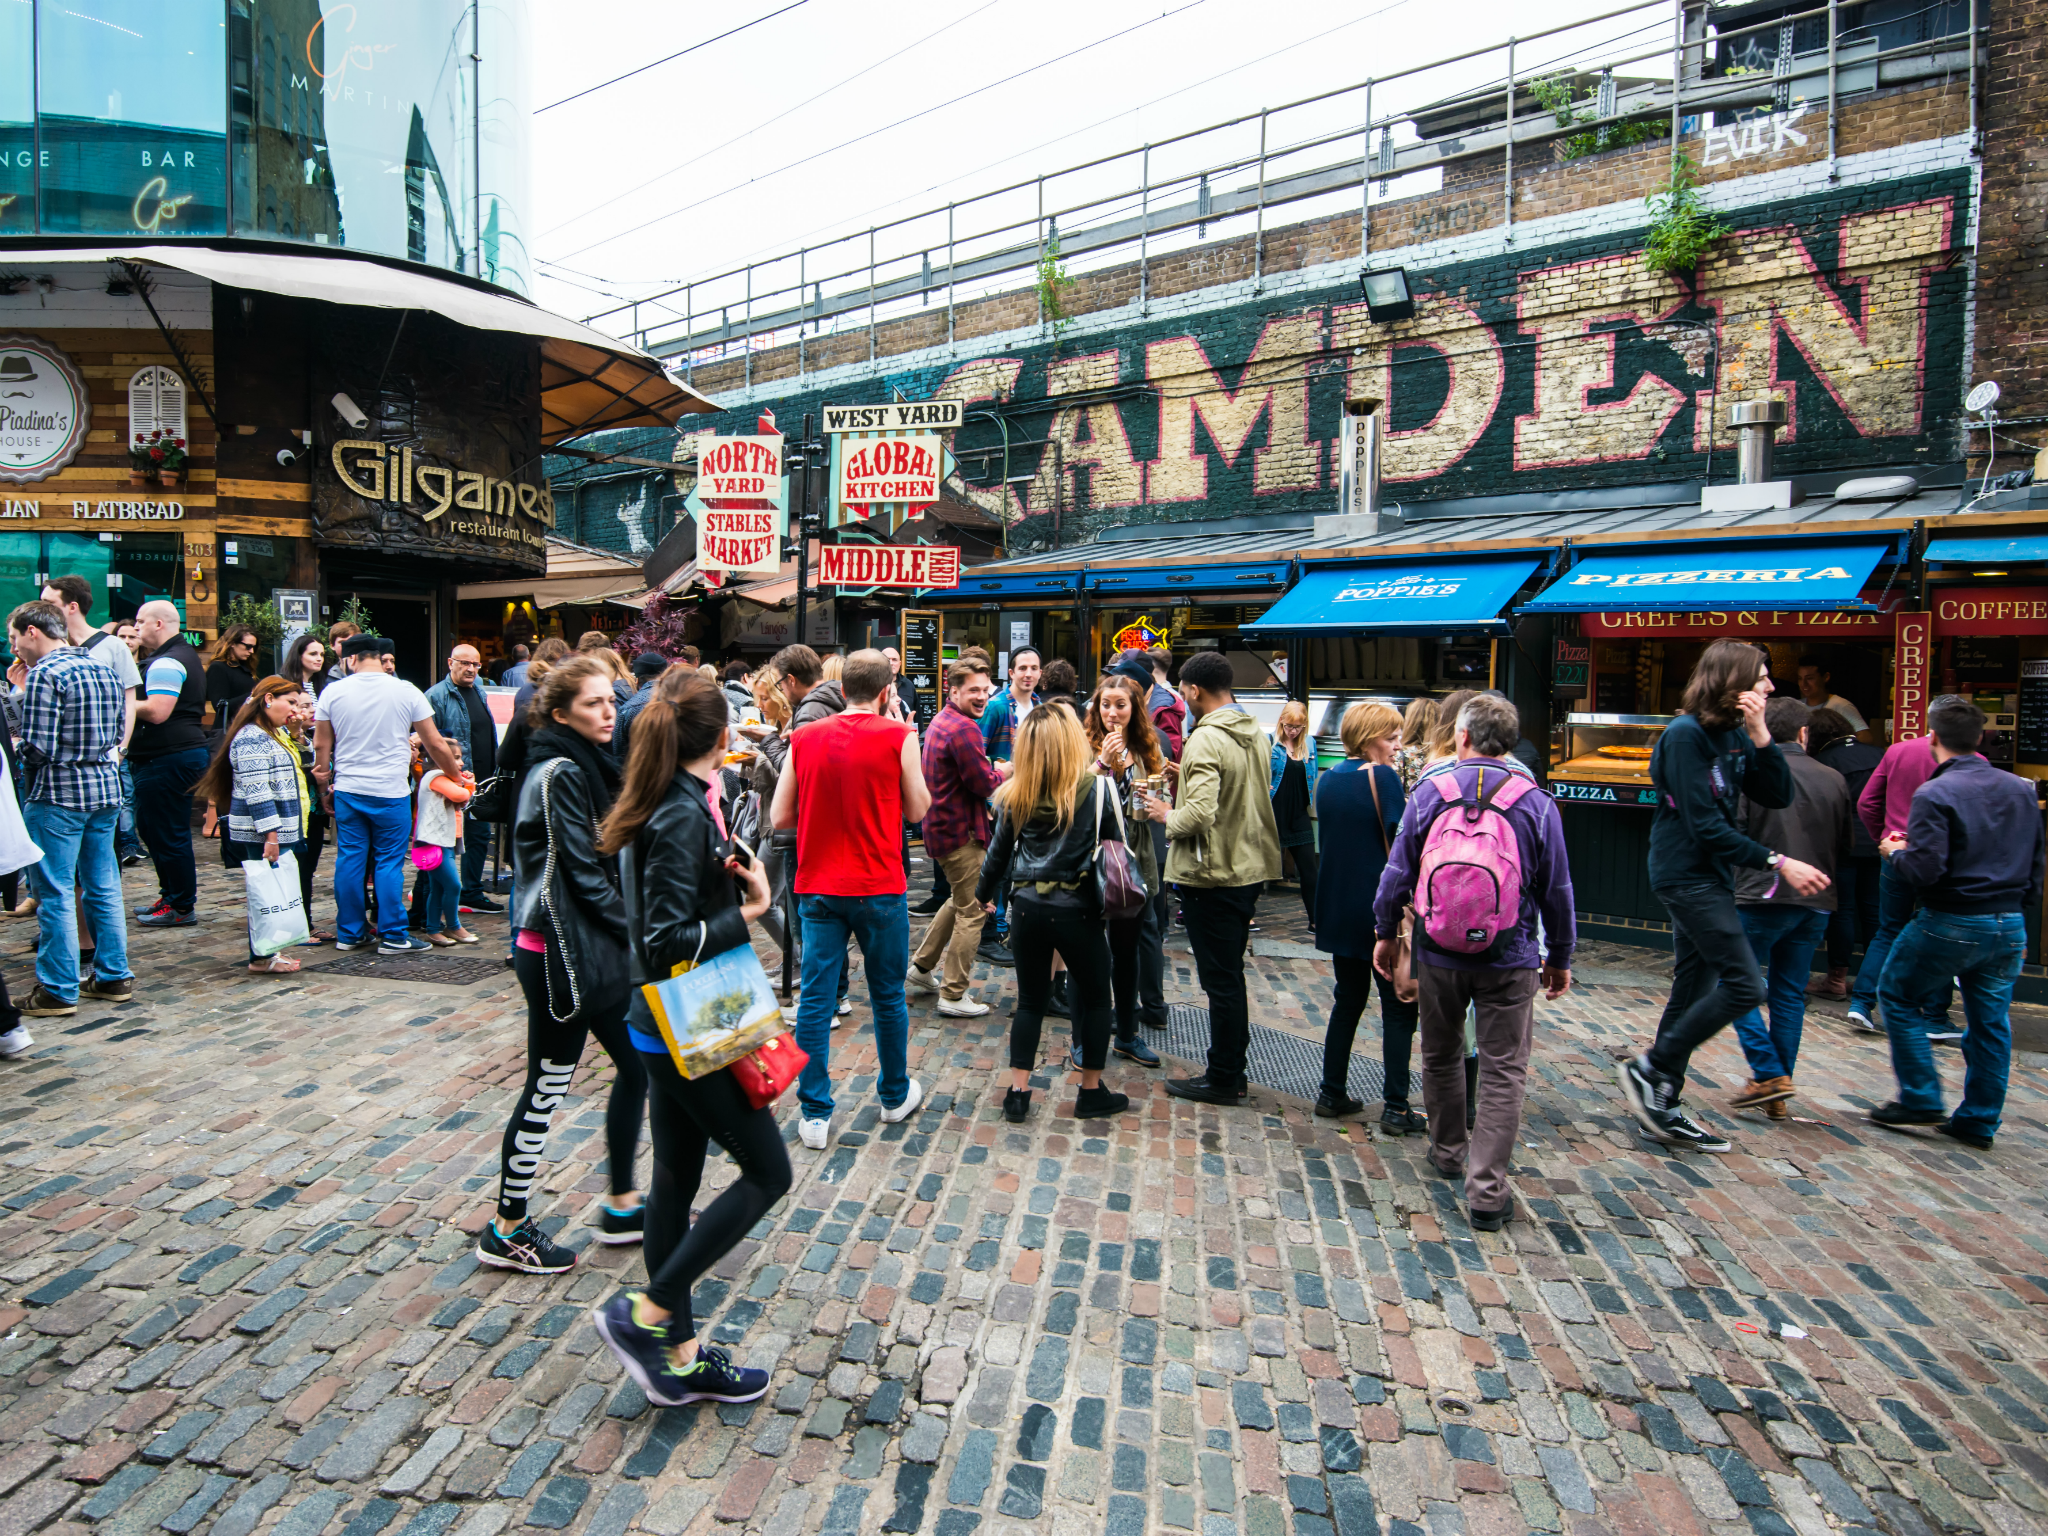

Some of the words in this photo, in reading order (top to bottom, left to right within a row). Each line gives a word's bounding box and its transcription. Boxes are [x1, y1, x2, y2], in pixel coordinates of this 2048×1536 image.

[307, 4, 398, 102] Ginger
[141, 151, 196, 168] BAR
[133, 177, 193, 235] Ginger
[926, 195, 1955, 527] CAMDEN
[0, 405, 68, 431] Piadina's
[827, 408, 889, 429] WEST
[896, 404, 958, 425] YARD
[702, 441, 777, 476] NORTH
[846, 441, 936, 480] GLOBAL
[1353, 422, 1365, 507] poppies
[713, 478, 765, 493] YARD
[845, 480, 935, 499] KITCHEN
[72, 501, 185, 520] FLATBREAD
[450, 519, 521, 541] restaurant
[706, 513, 772, 533] STABLES
[185, 543, 214, 557] 303
[702, 532, 775, 566] MARKET
[822, 547, 926, 583] MIDDLE
[929, 550, 955, 583] YARD
[1569, 566, 1853, 586] PIZZERIA
[1334, 583, 1462, 600] POPPIE'S
[1737, 611, 1760, 627] &
[1939, 600, 2048, 621] COFFEE
[1141, 629, 1150, 641] &
[1556, 640, 1589, 661] Pizza
[1554, 782, 1618, 801] PIZZA
